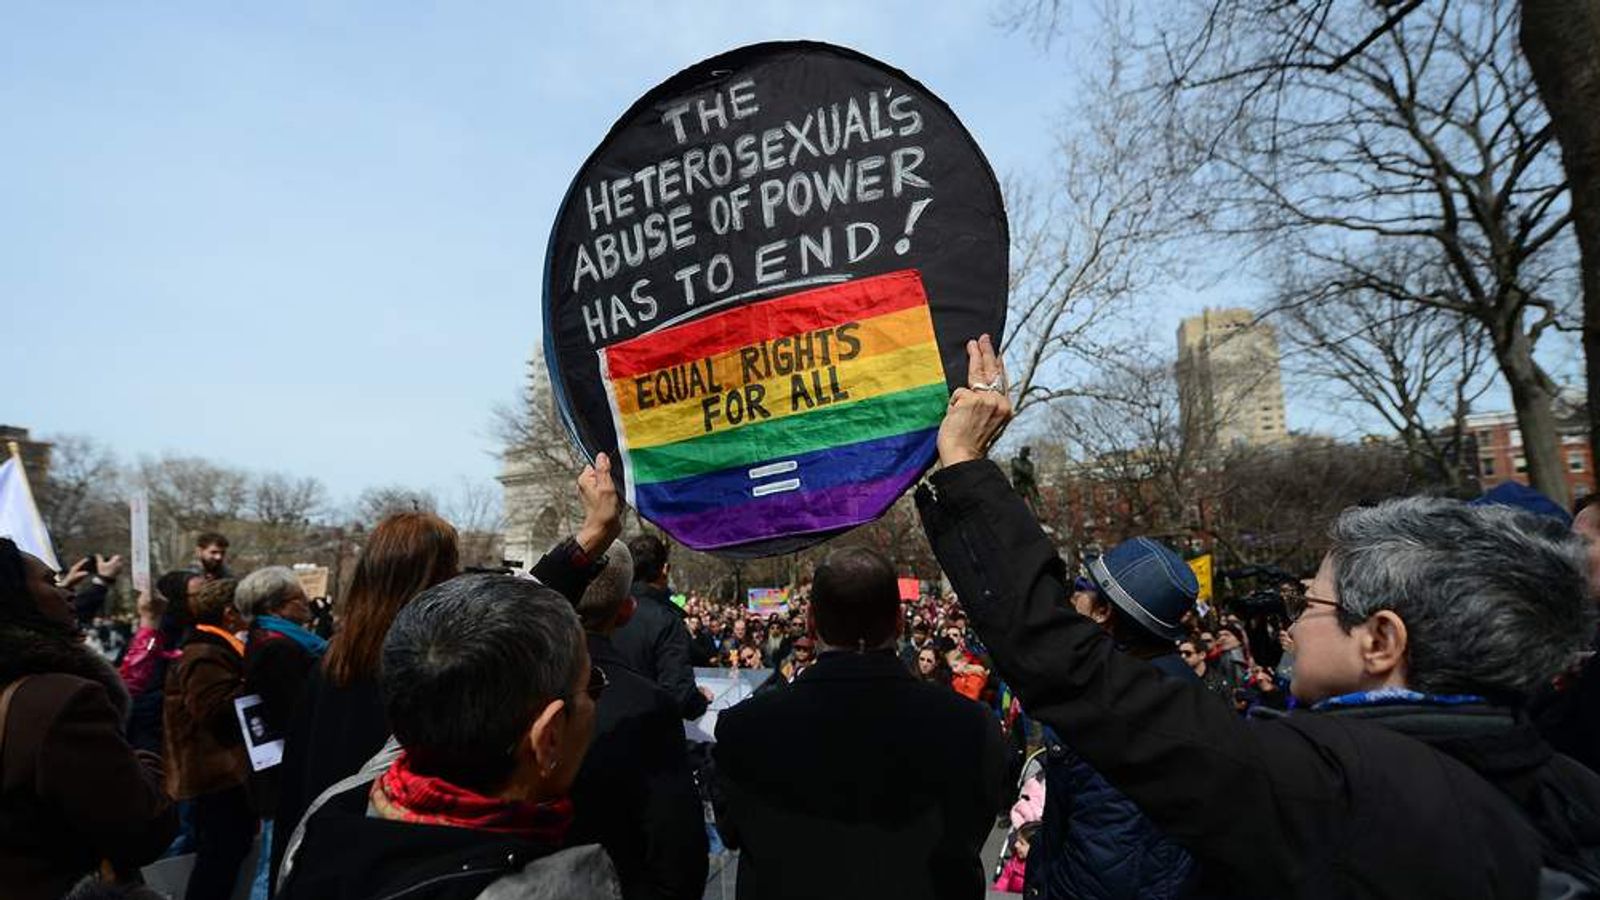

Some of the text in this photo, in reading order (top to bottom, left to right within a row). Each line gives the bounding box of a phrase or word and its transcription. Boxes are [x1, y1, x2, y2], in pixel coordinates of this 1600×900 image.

[584, 86, 924, 231] HETEROSEXUAL'S
[661, 78, 761, 144] THE
[573, 145, 931, 293] ABUSE OF POWER
[582, 197, 934, 345] HAS TO END!
[633, 322, 863, 410] EQUAL RIGHTS
[701, 364, 849, 432] FOR ALL
